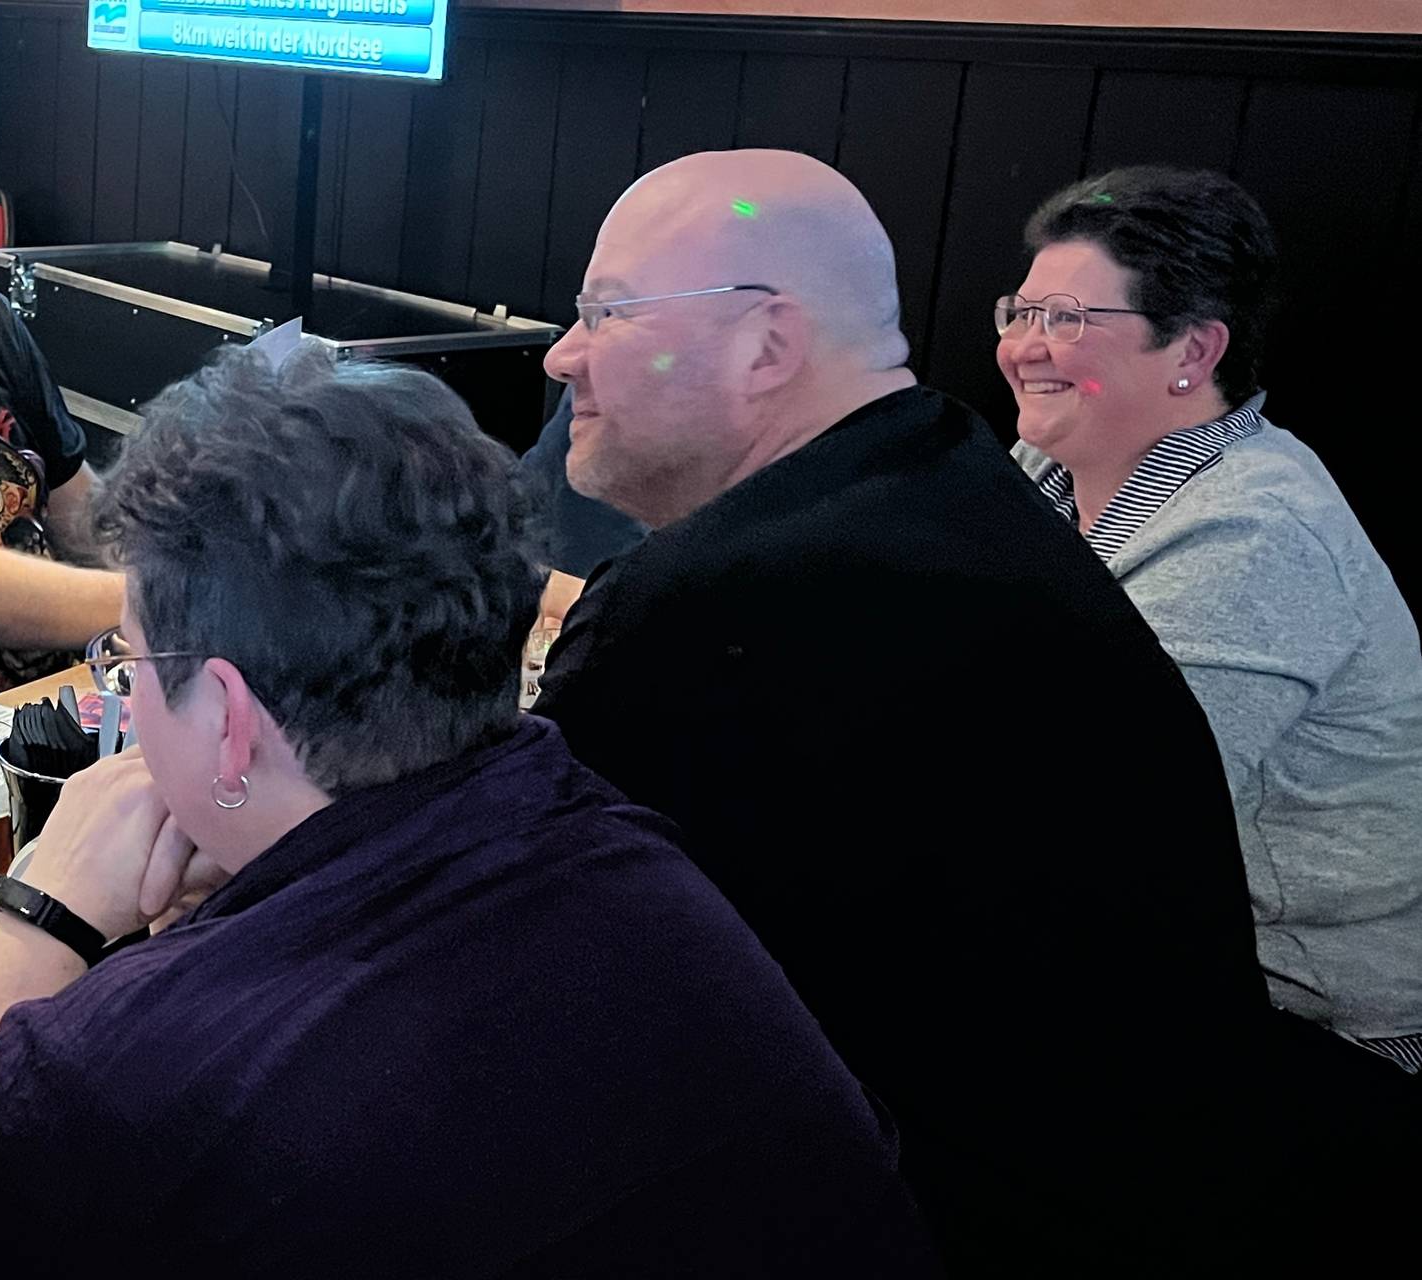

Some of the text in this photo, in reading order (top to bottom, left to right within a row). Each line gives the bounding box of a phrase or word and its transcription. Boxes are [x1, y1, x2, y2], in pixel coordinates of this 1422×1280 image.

[173, 20, 383, 62] 8km weit in der Nordsee
